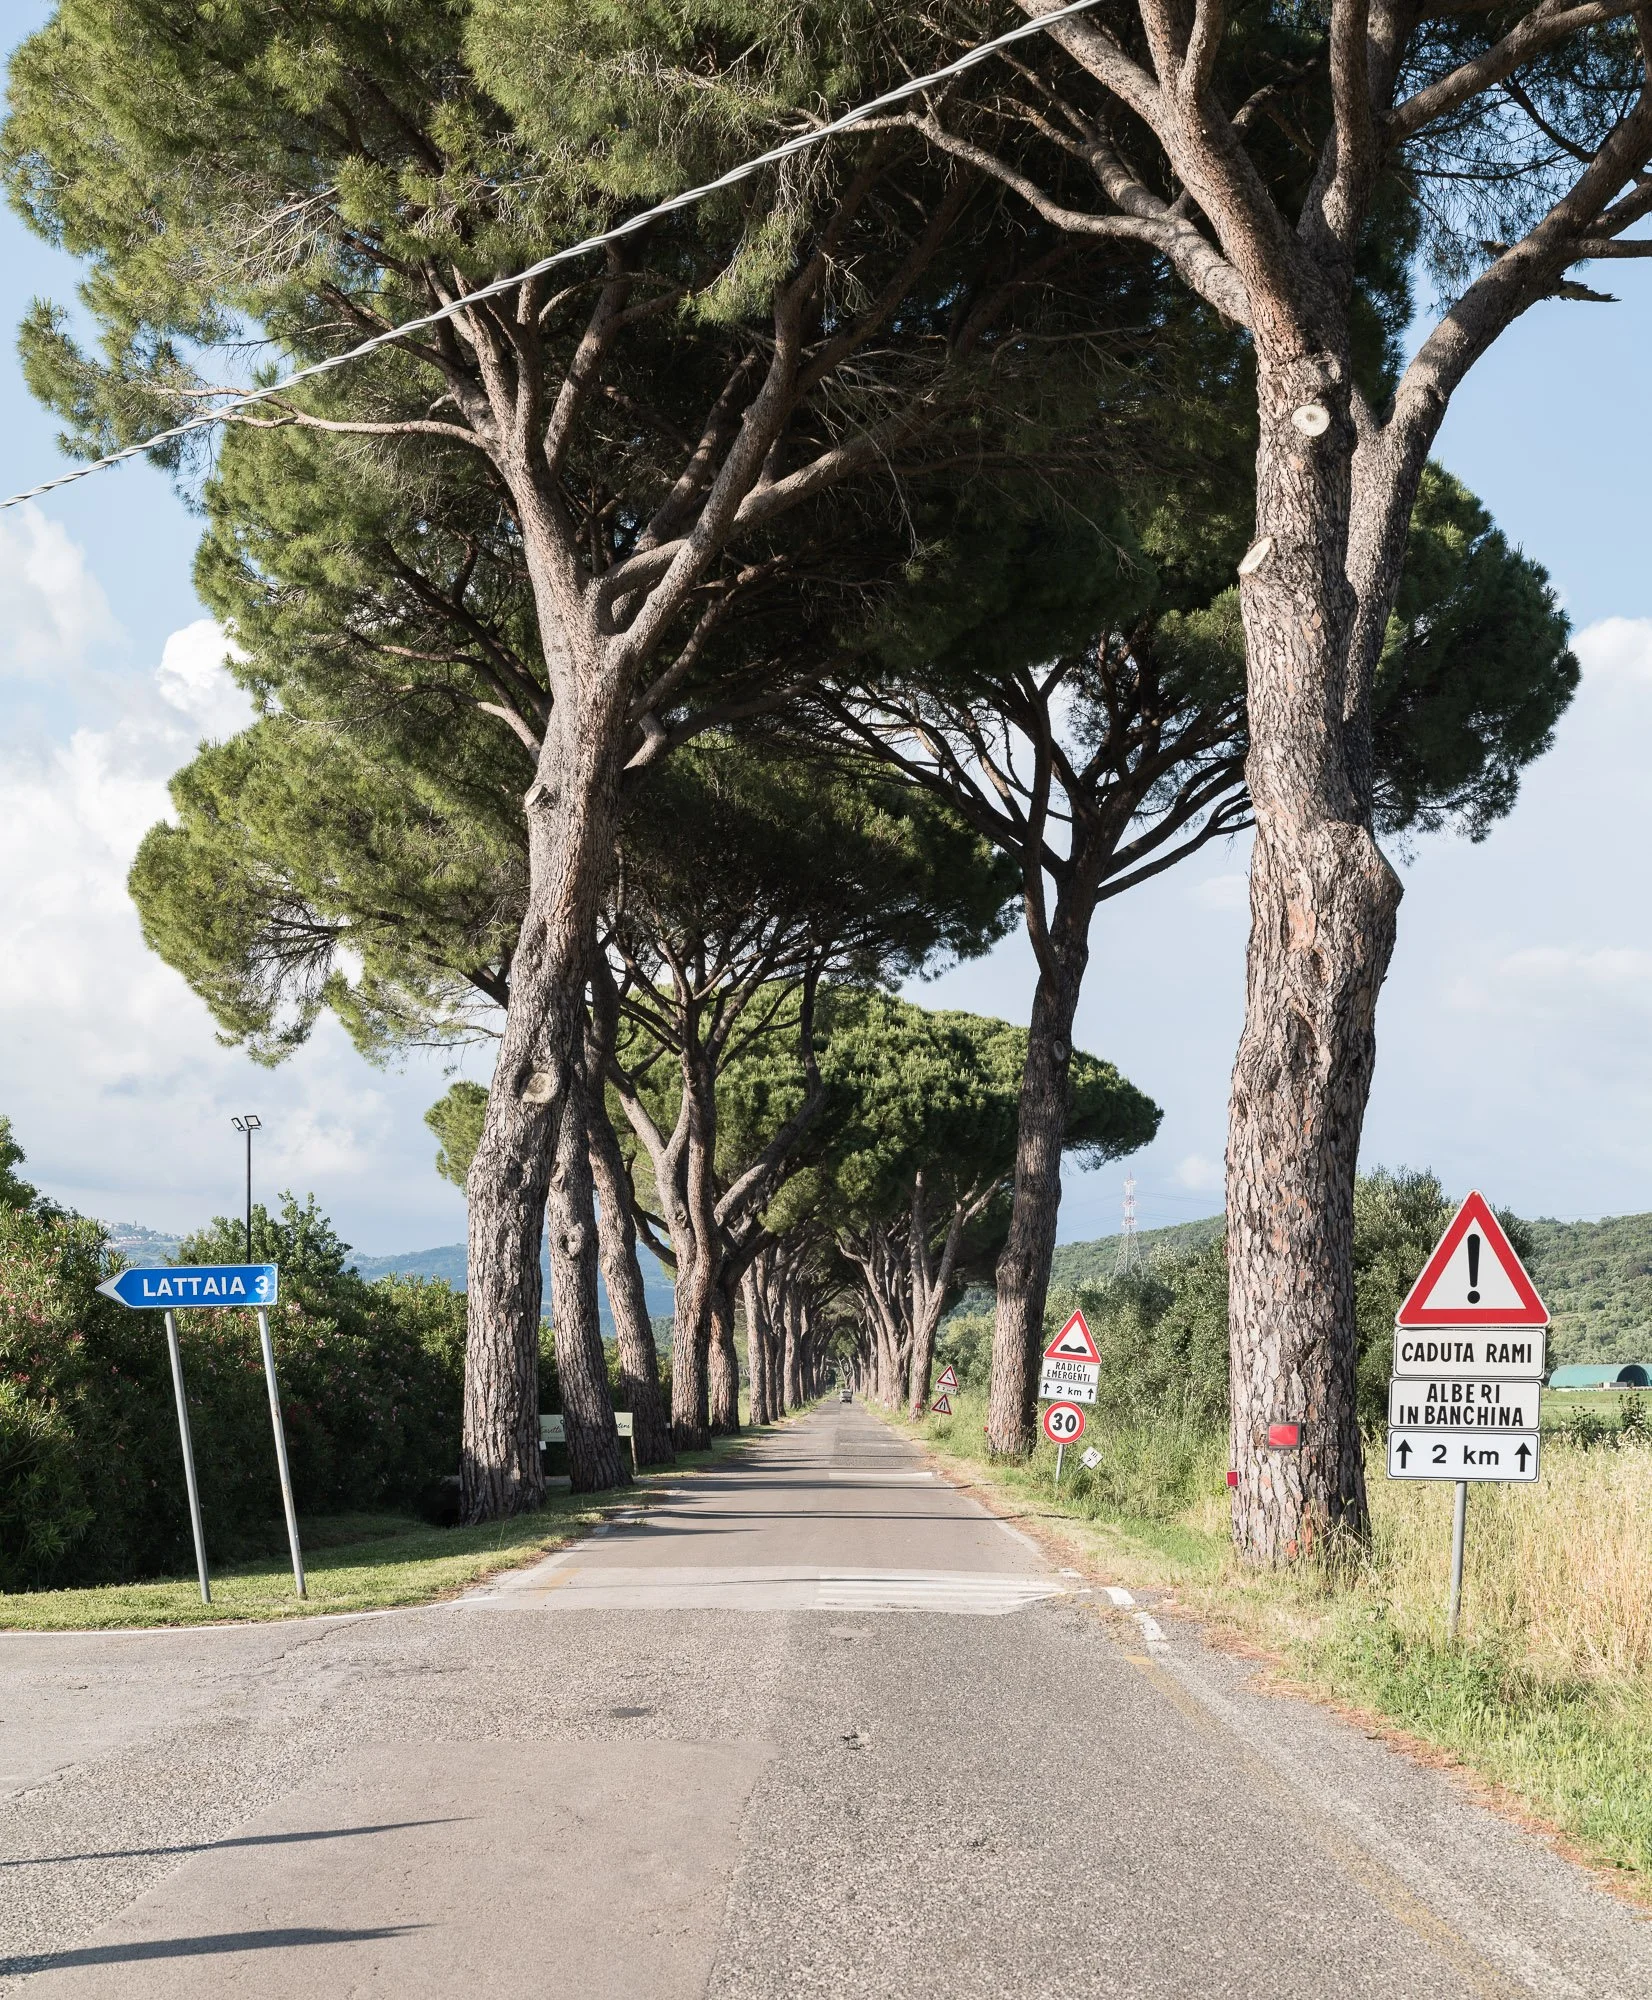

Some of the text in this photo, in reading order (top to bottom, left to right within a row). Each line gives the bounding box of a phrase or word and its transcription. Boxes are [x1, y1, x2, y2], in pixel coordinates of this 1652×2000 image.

[143, 1275, 269, 1297] LATTAIA 3
[1401, 1342, 1532, 1363] CADUTA RAMI
[1046, 1369, 1091, 1382] EMERGENTI
[1055, 1361, 1086, 1373] RADICI
[1056, 1385, 1082, 1397] 2 km
[1426, 1383, 1500, 1404] ALBERI
[1052, 1412, 1077, 1433] 30
[1400, 1404, 1524, 1427] IN BANCHINA
[1431, 1444, 1500, 1465] 2 km
